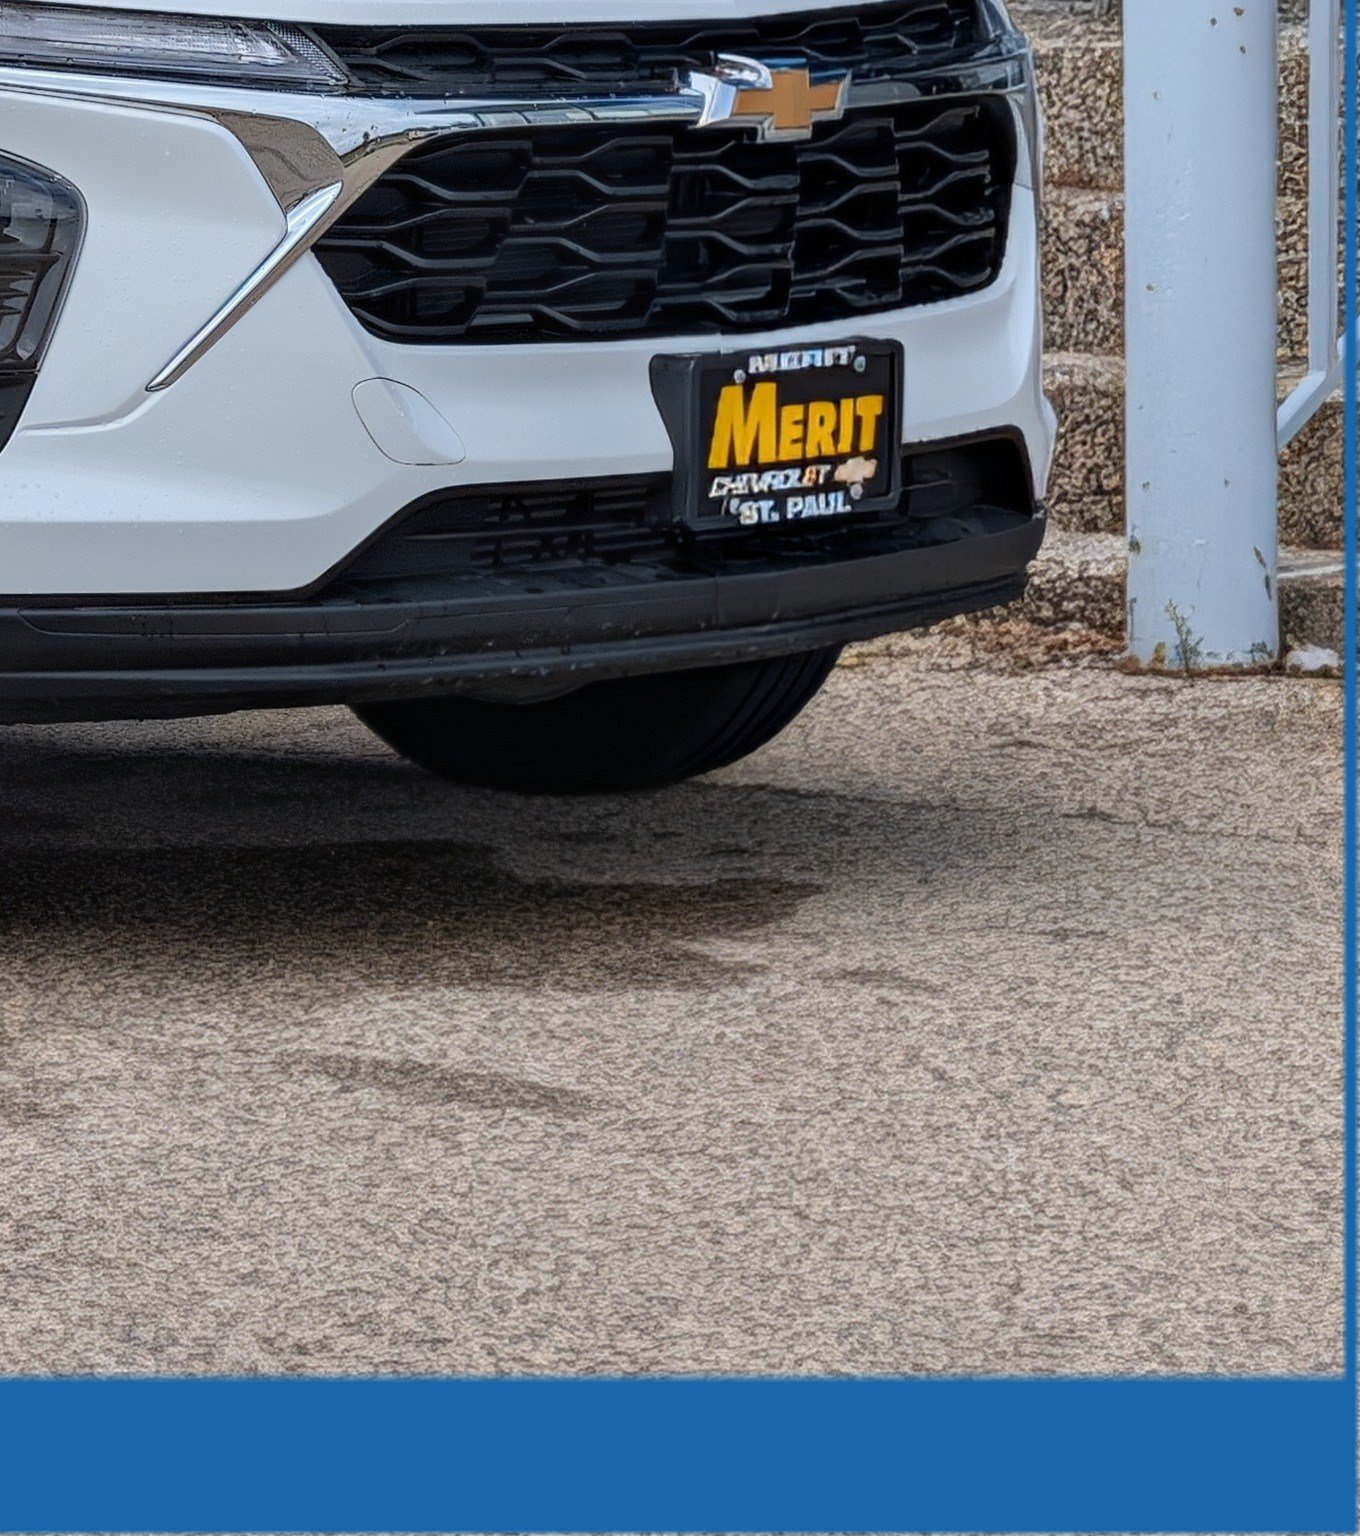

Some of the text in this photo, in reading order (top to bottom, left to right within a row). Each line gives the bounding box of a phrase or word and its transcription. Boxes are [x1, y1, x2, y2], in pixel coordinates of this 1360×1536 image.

[708, 382, 882, 469] MERIT
[738, 491, 851, 525] ST. PAUL
